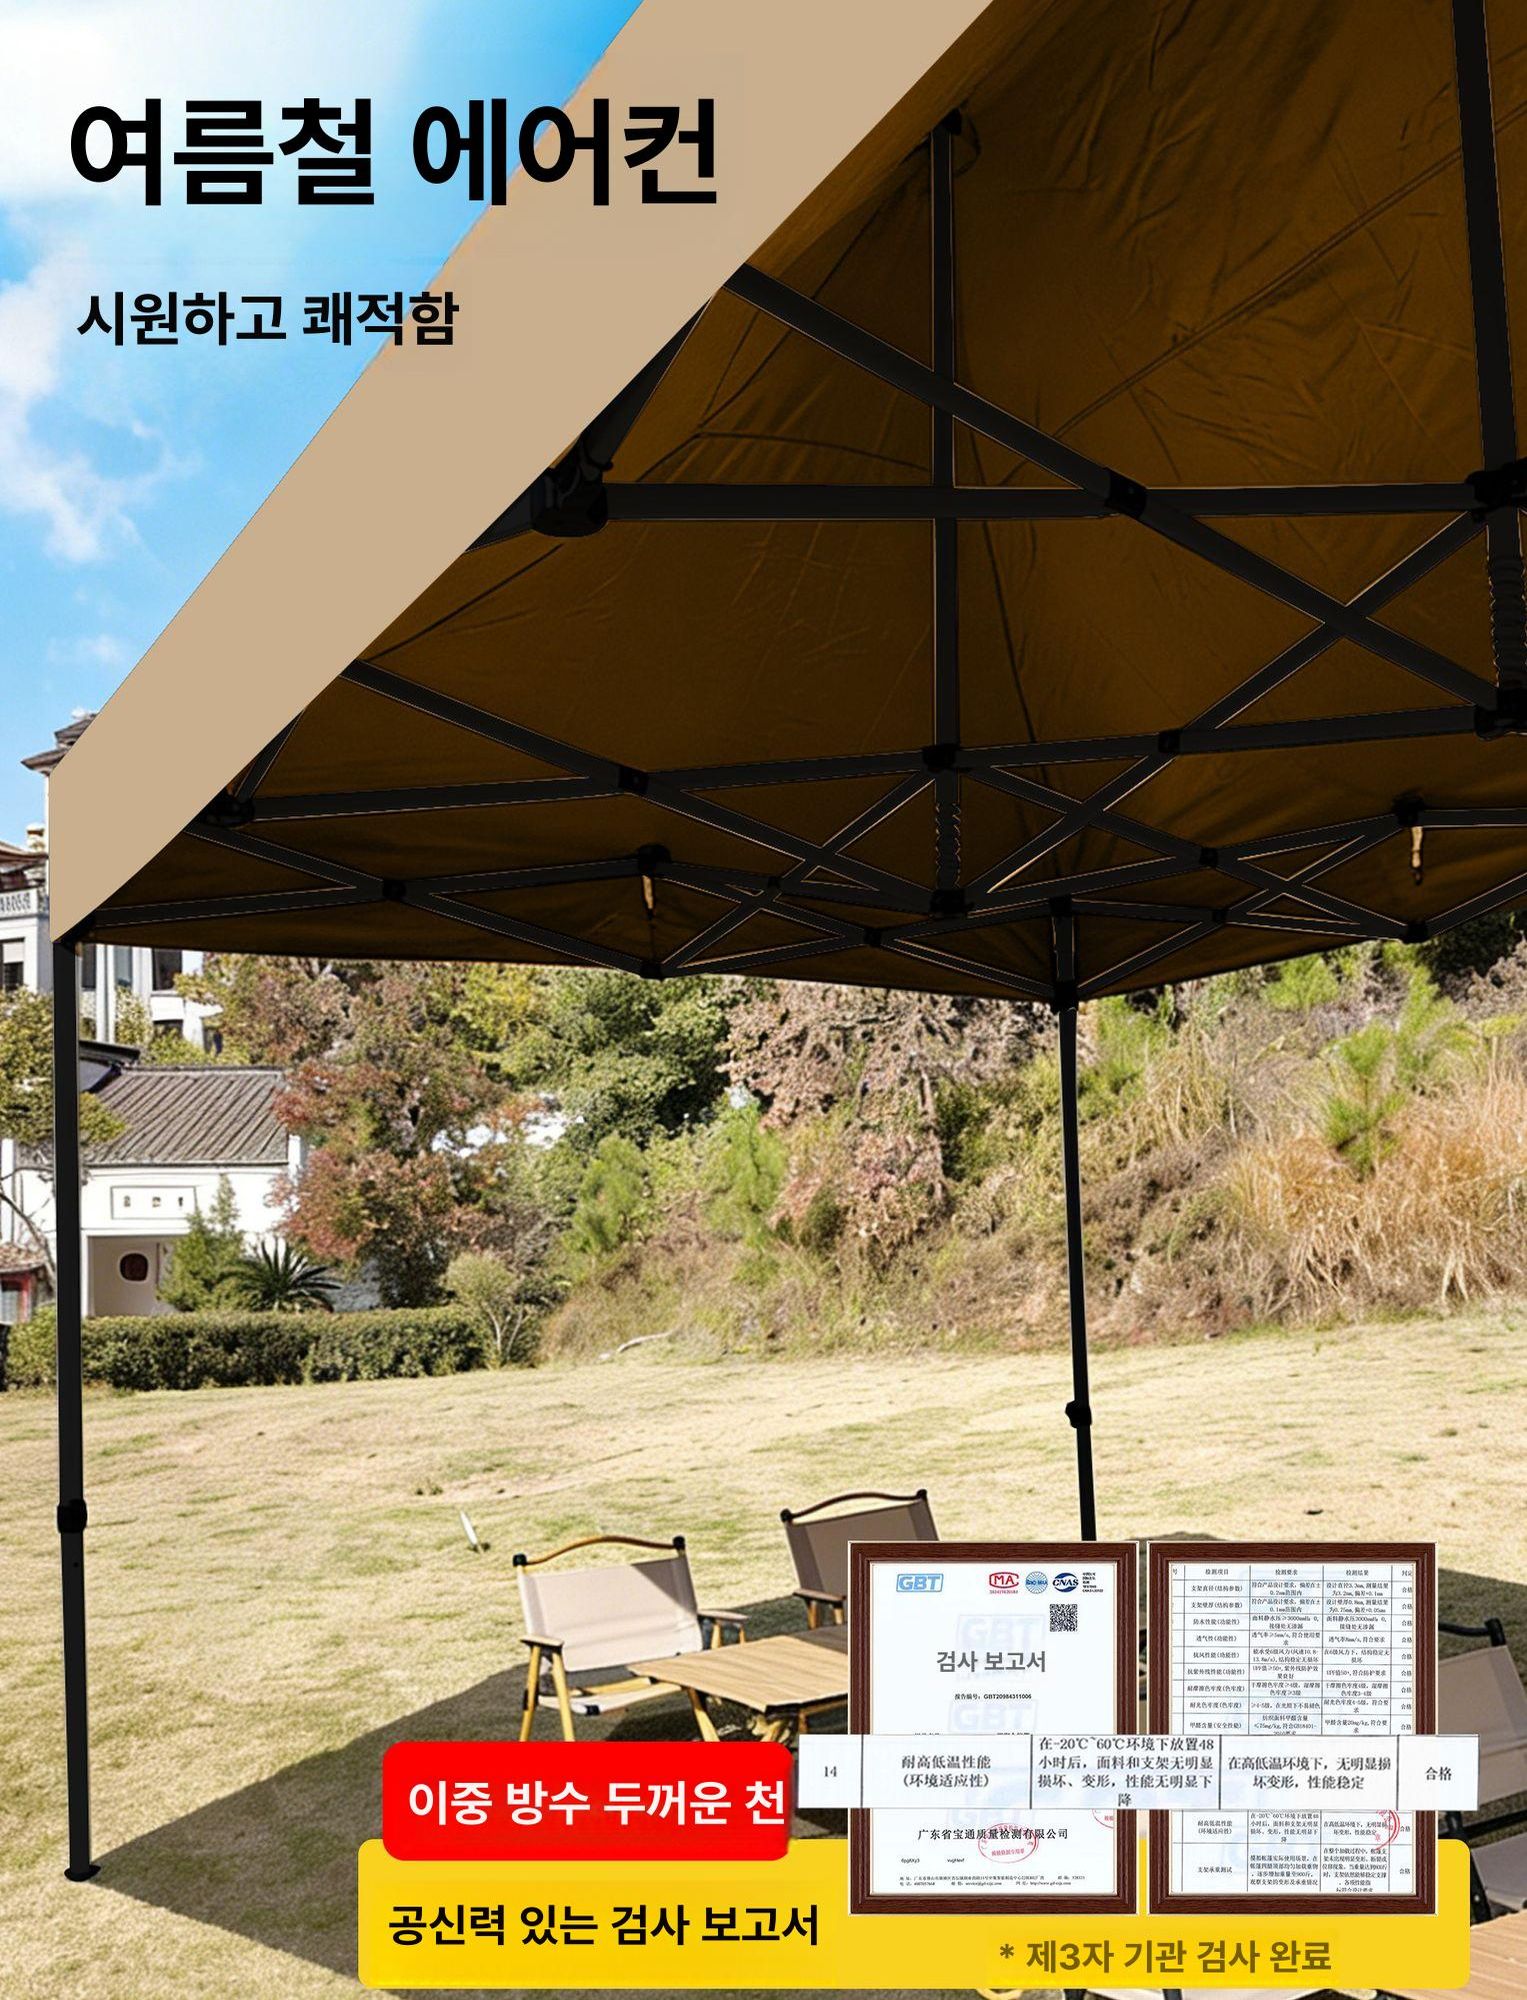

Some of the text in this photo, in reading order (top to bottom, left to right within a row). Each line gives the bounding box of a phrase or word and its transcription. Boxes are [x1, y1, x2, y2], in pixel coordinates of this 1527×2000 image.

[898, 1575, 943, 1590] GBT
[1052, 1579, 1079, 1587] CNAS
[936, 1651, 1047, 1673] 검사 보고서
[901, 1755, 991, 1769] 耐高低温性能
[824, 1766, 837, 1777] 14
[1425, 1767, 1452, 1781] 合格
[1118, 1793, 1132, 1806] 降
[917, 1829, 1068, 1840] 广东省宝通质量检测有限公司
